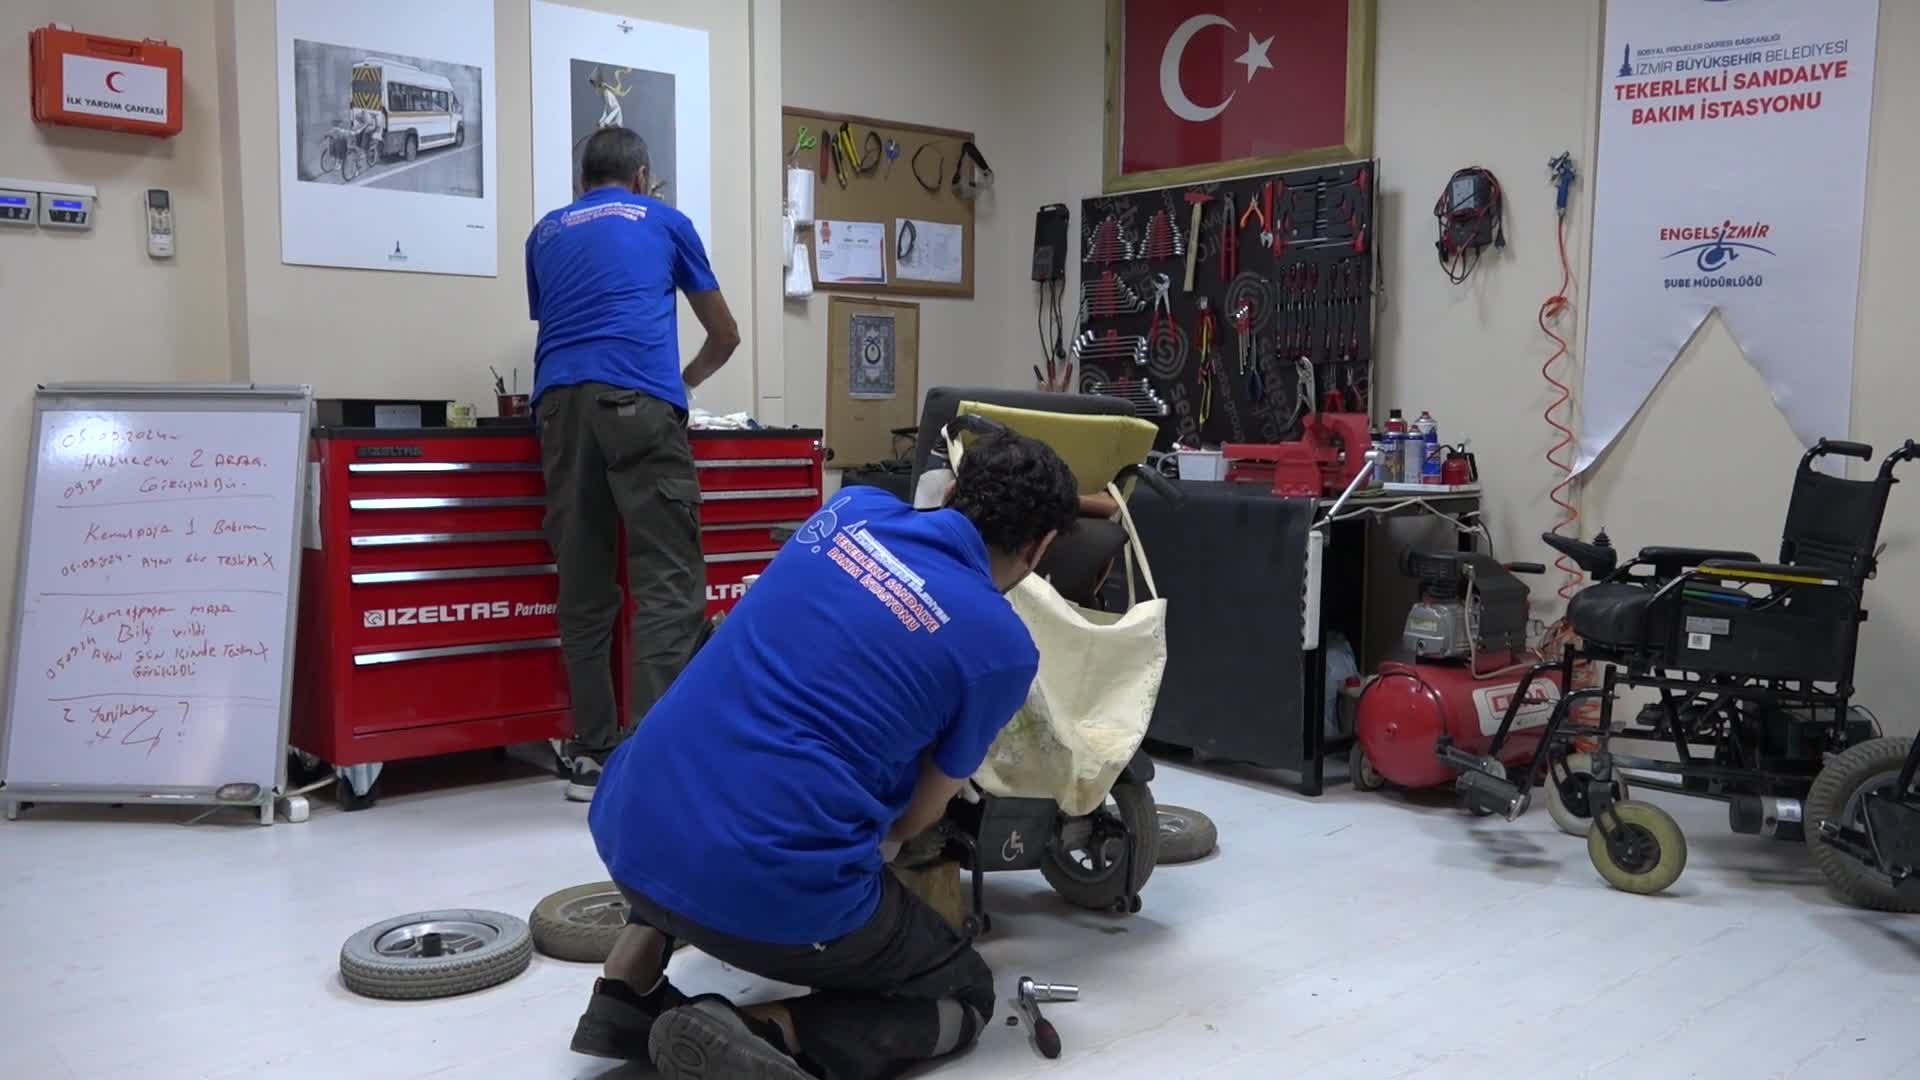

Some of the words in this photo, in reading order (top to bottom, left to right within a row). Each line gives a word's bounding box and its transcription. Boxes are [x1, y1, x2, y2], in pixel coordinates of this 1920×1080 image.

[1675, 52, 1762, 72] BÜYÜKŞEHİR
[1765, 40, 1849, 63] BELEDİYESİ
[1615, 70, 1728, 101] TEKERLEKLİ
[1733, 60, 1848, 91] SANDALYE
[84, 99, 122, 111] YARDIM
[124, 104, 164, 116] ÇANTASI
[1631, 104, 1695, 125] BAKIM
[1700, 91, 1822, 120] İSTASYONU
[1664, 278, 1691, 290] ŞUBE
[1693, 275, 1763, 288] MÜDÜRLÜĞÜ
[387, 601, 509, 626] IZELTAS
[514, 603, 558, 617] Partner
